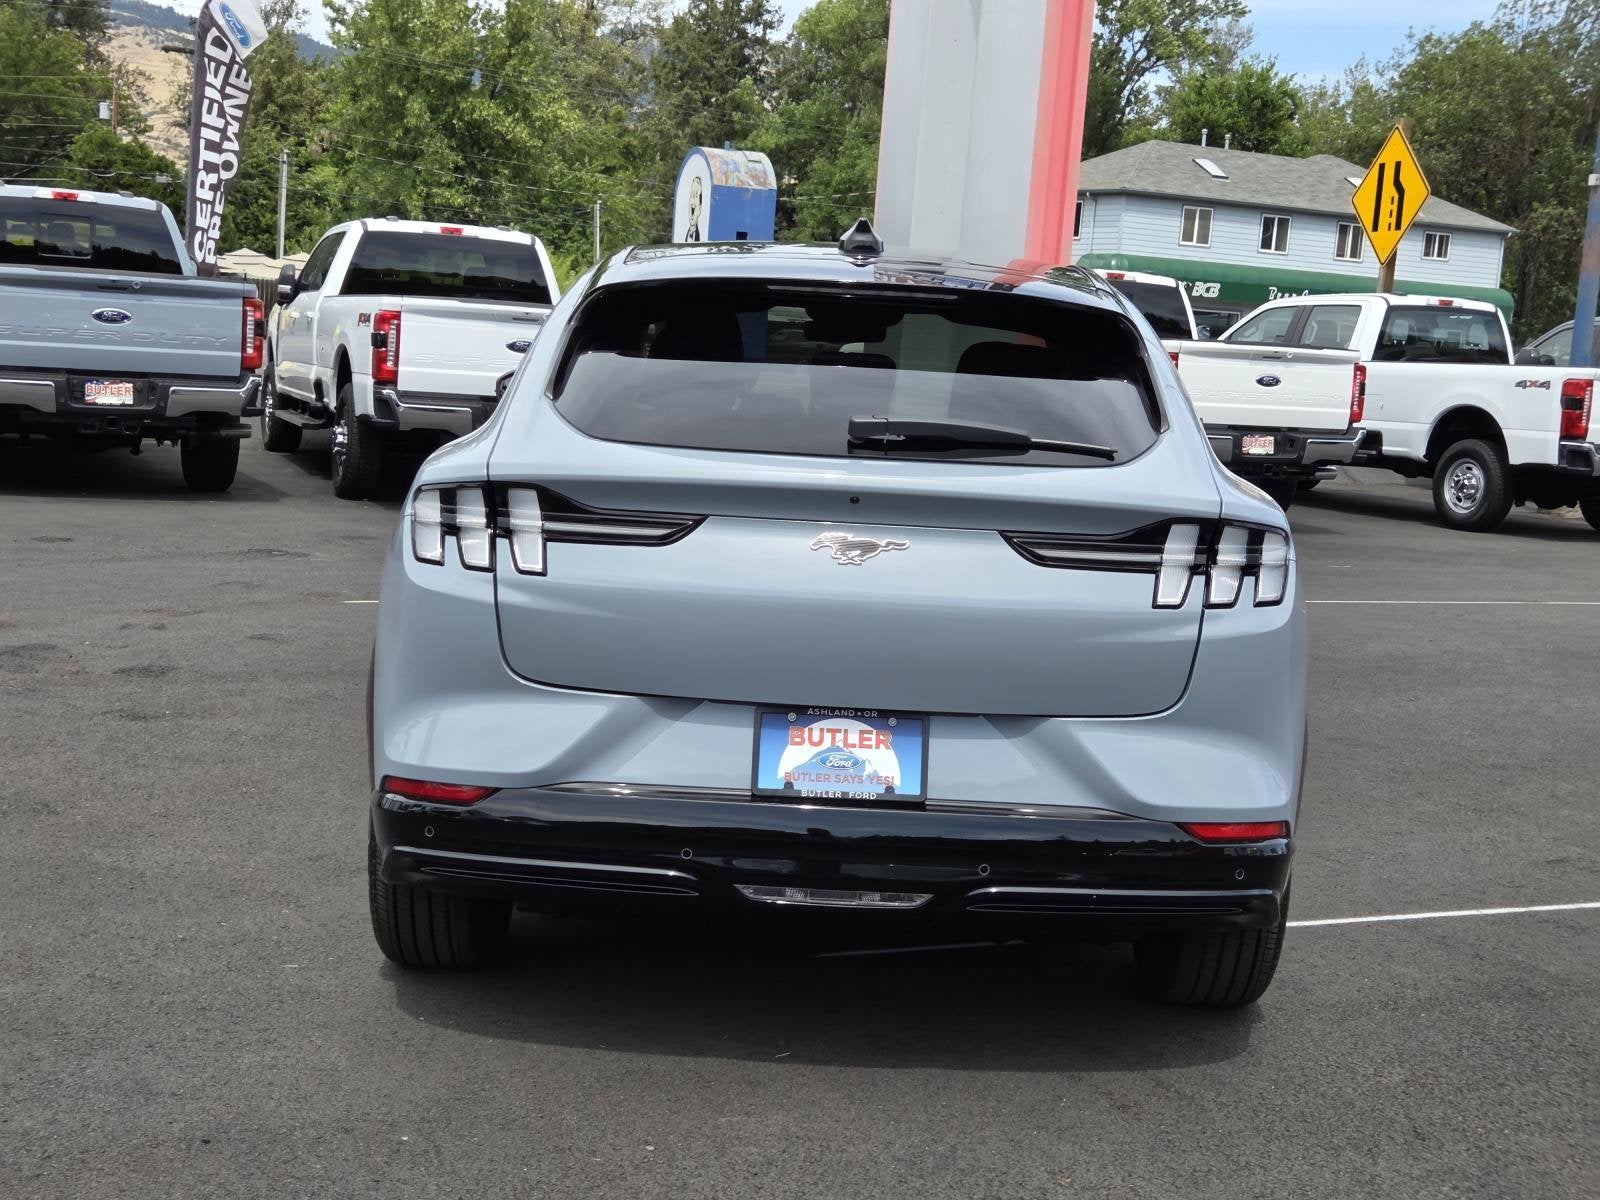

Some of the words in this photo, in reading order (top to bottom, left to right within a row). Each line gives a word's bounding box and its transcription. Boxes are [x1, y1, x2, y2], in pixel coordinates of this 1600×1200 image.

[194, 26, 233, 263] CERTIFIED
[204, 53, 253, 265] PRE-OWNE
[132, 331, 230, 345] DUTY
[86, 384, 132, 396] BUTLER
[807, 707, 856, 718] ASHLAND
[863, 710, 879, 719] OR
[788, 725, 893, 751] BUTLER
[825, 753, 855, 769] Ford
[783, 771, 833, 784] BUTLER
[834, 774, 865, 785] SAYS
[866, 776, 896, 786] YES!
[801, 789, 843, 799] BUTLER
[849, 791, 878, 801] FORD
